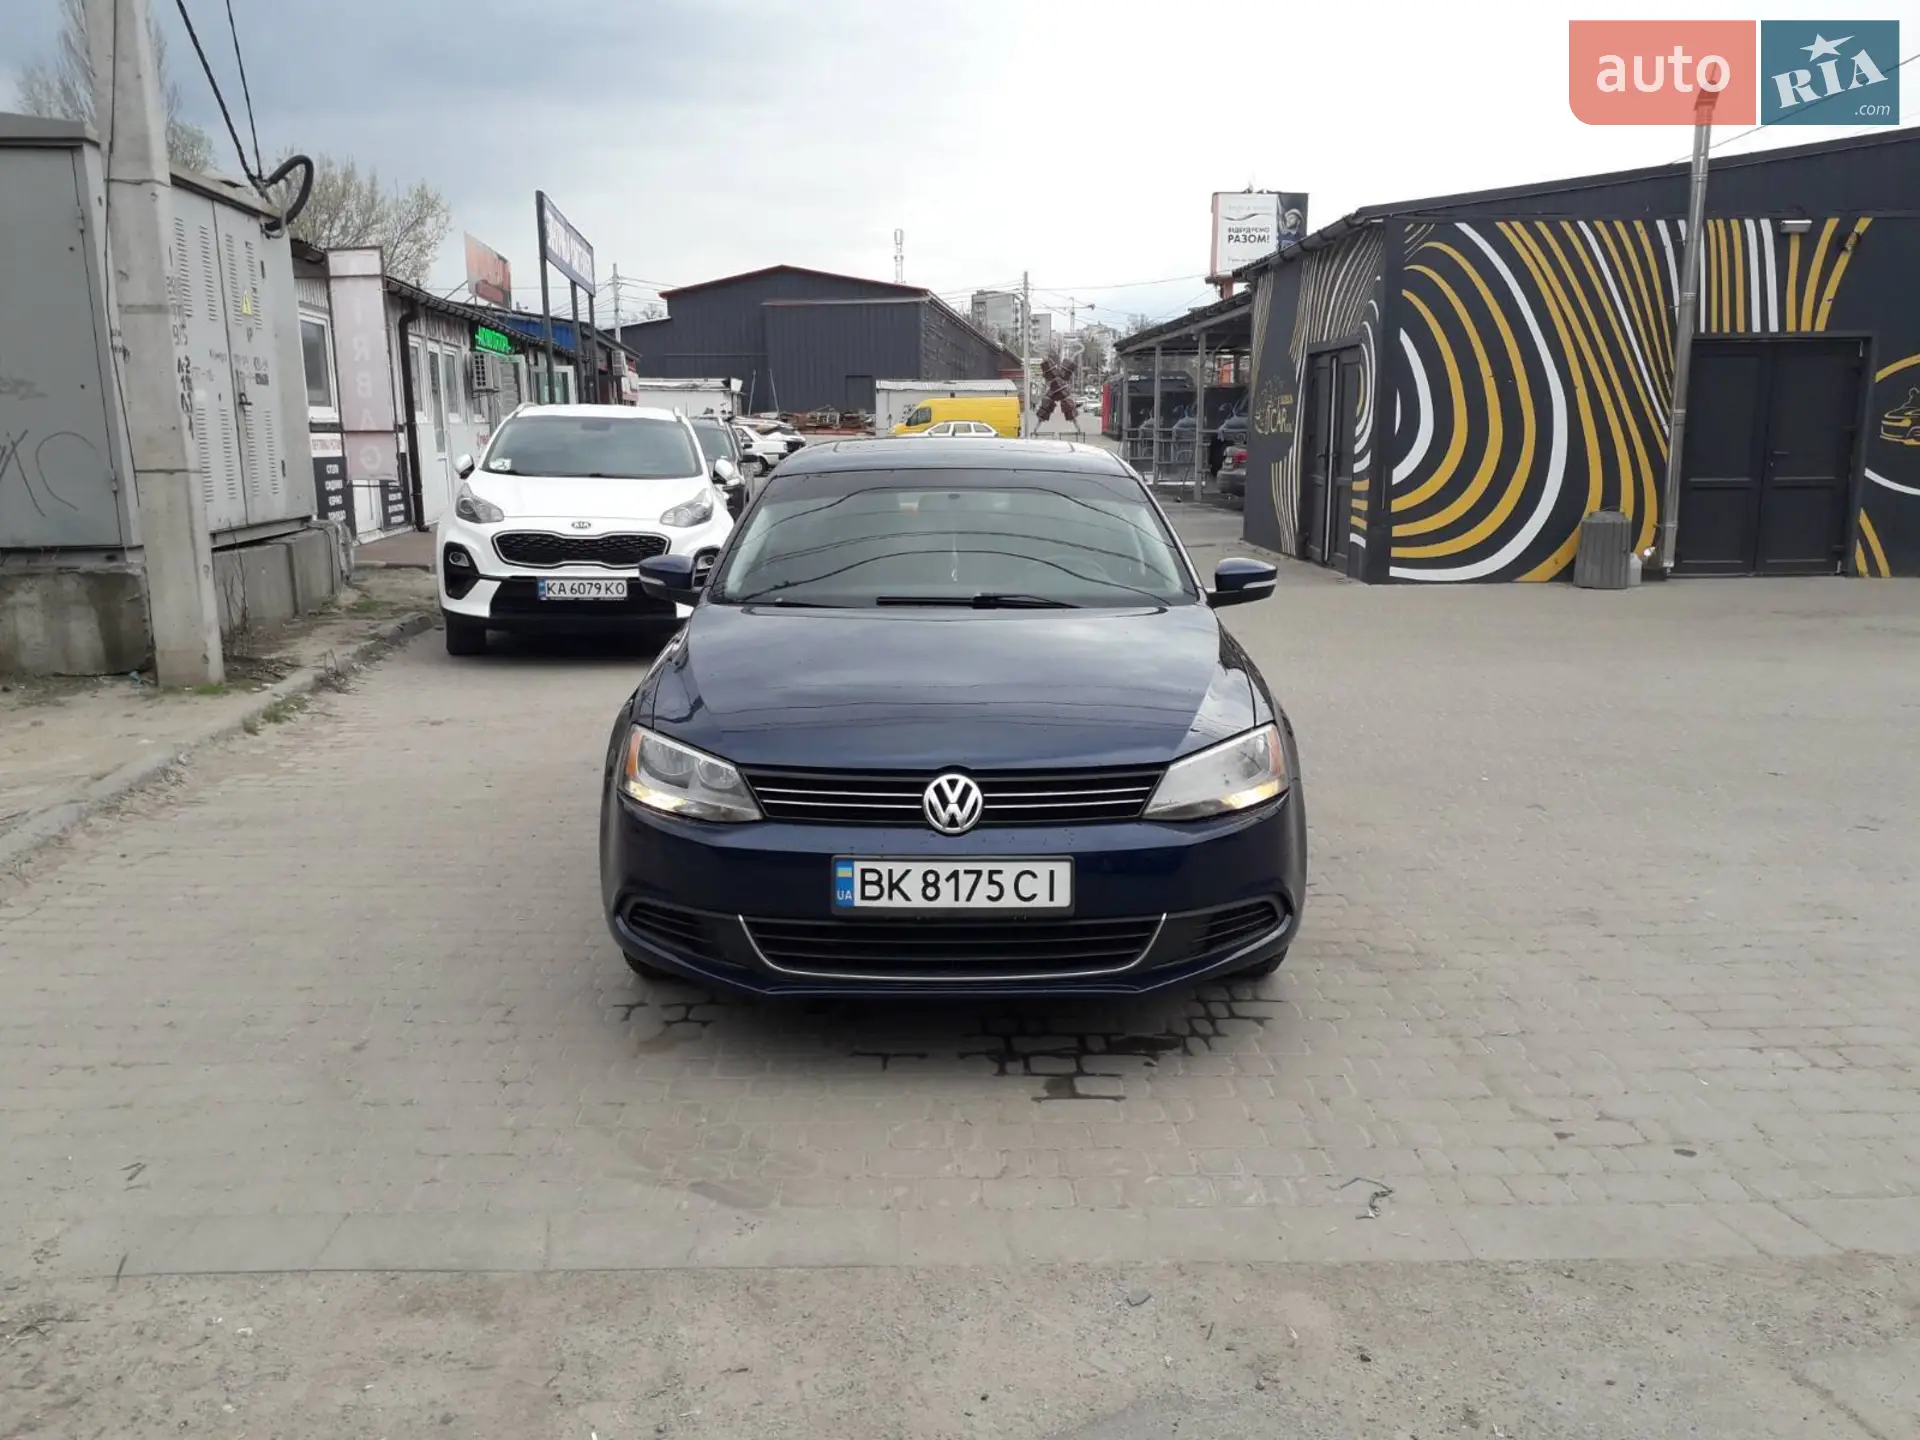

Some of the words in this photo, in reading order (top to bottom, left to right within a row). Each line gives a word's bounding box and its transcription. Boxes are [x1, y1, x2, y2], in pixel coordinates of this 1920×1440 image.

[1228, 234, 1270, 244] РАЗОМ!
[572, 521, 591, 529] KIA
[546, 582, 567, 595] KA
[569, 582, 602, 595] 6079
[604, 582, 625, 595] KO
[859, 867, 912, 902] BK
[921, 868, 1005, 902] 8175
[1013, 868, 1055, 902] CI
[836, 890, 853, 901] UA
